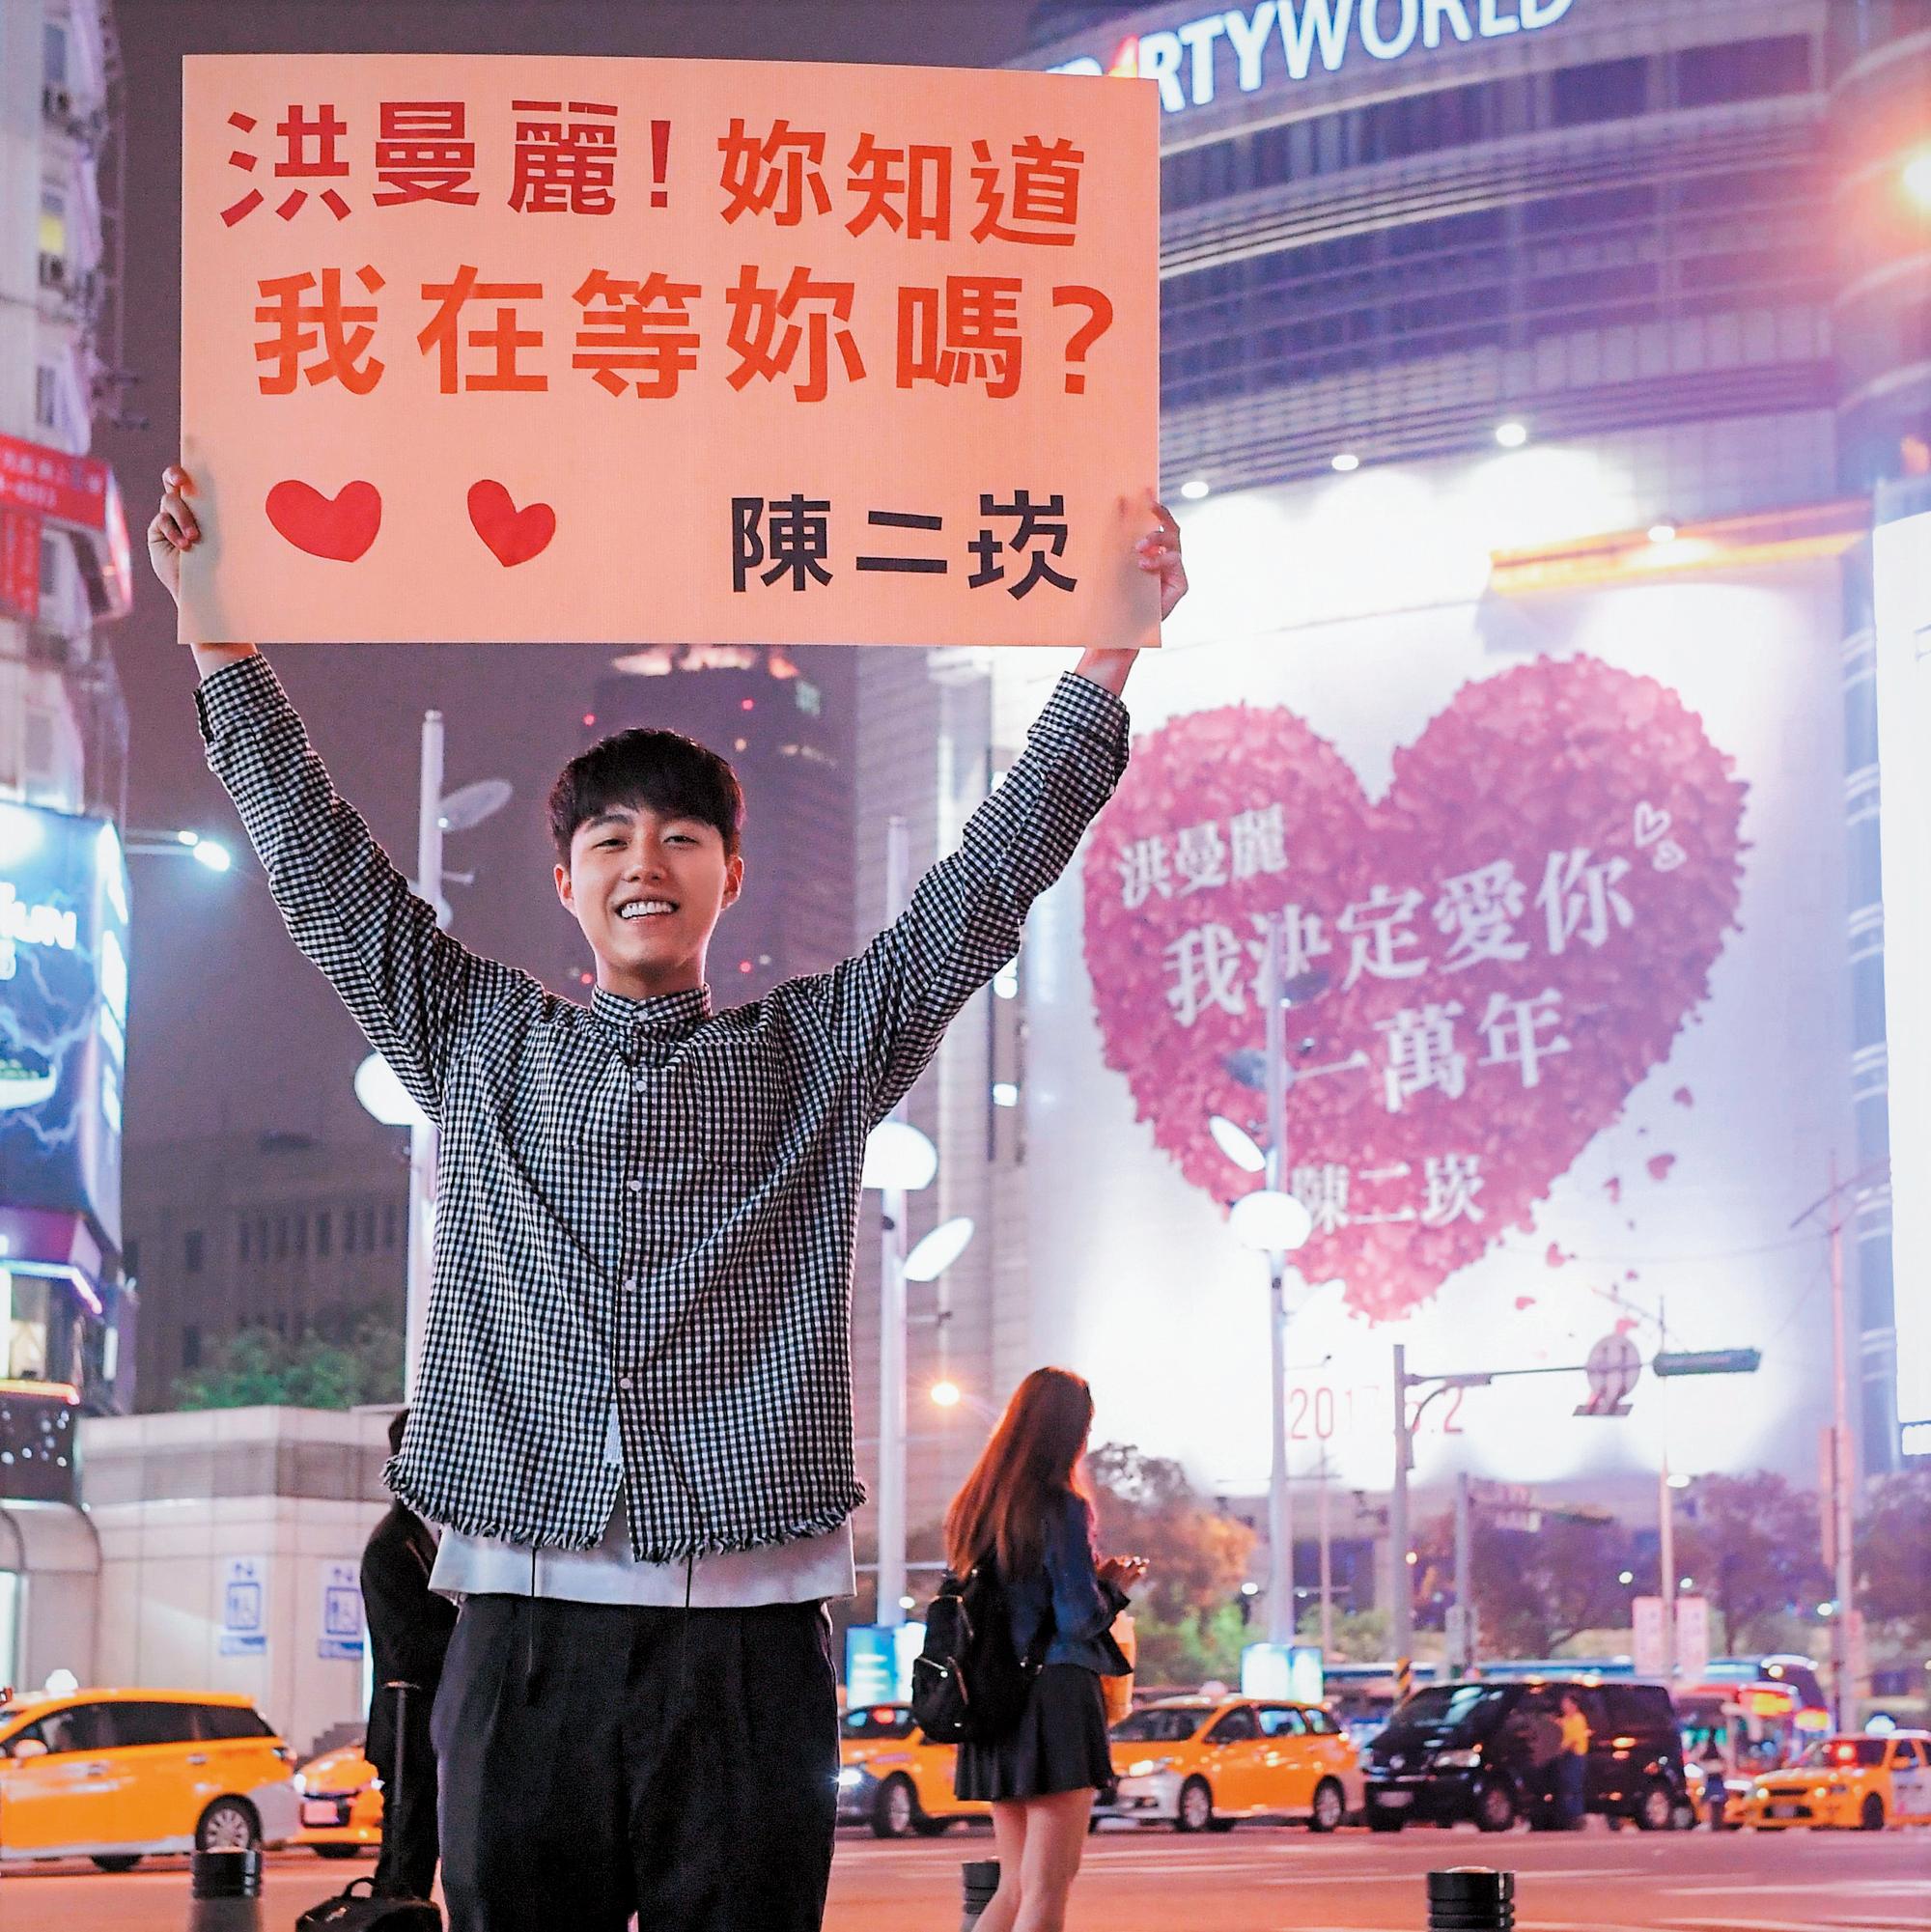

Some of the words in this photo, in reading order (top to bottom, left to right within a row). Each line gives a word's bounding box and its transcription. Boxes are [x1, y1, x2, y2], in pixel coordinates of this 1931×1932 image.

[1047, 0, 1573, 113] RTYWORL
[732, 490, 1077, 601] 陳二崁
[1121, 803, 1289, 909] 洪曼麗
[1291, 988, 1572, 1110] 一萬年
[1291, 1153, 1485, 1235] 陳二崁
